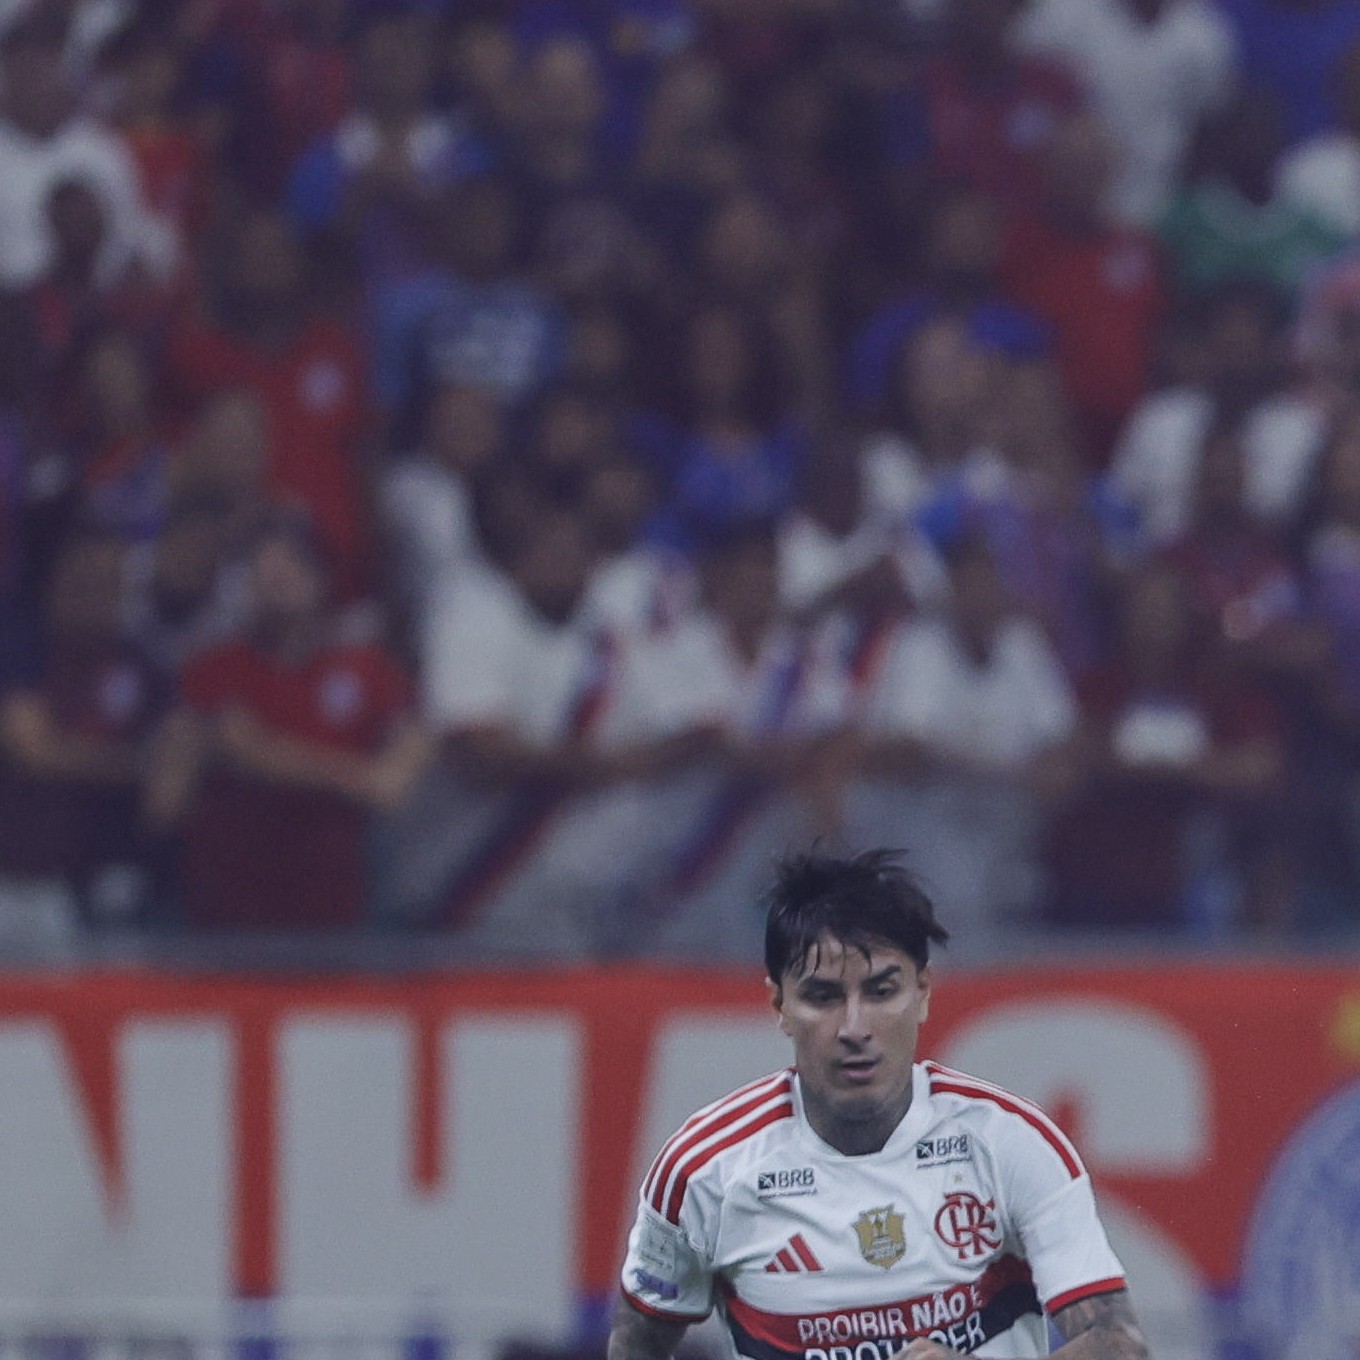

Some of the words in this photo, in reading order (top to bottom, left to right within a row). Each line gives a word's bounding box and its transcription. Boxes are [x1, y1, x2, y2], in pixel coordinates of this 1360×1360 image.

[778, 1168, 815, 1188] BRB
[798, 1308, 908, 1346] PROIBIR
[911, 1291, 966, 1332] NÃO
